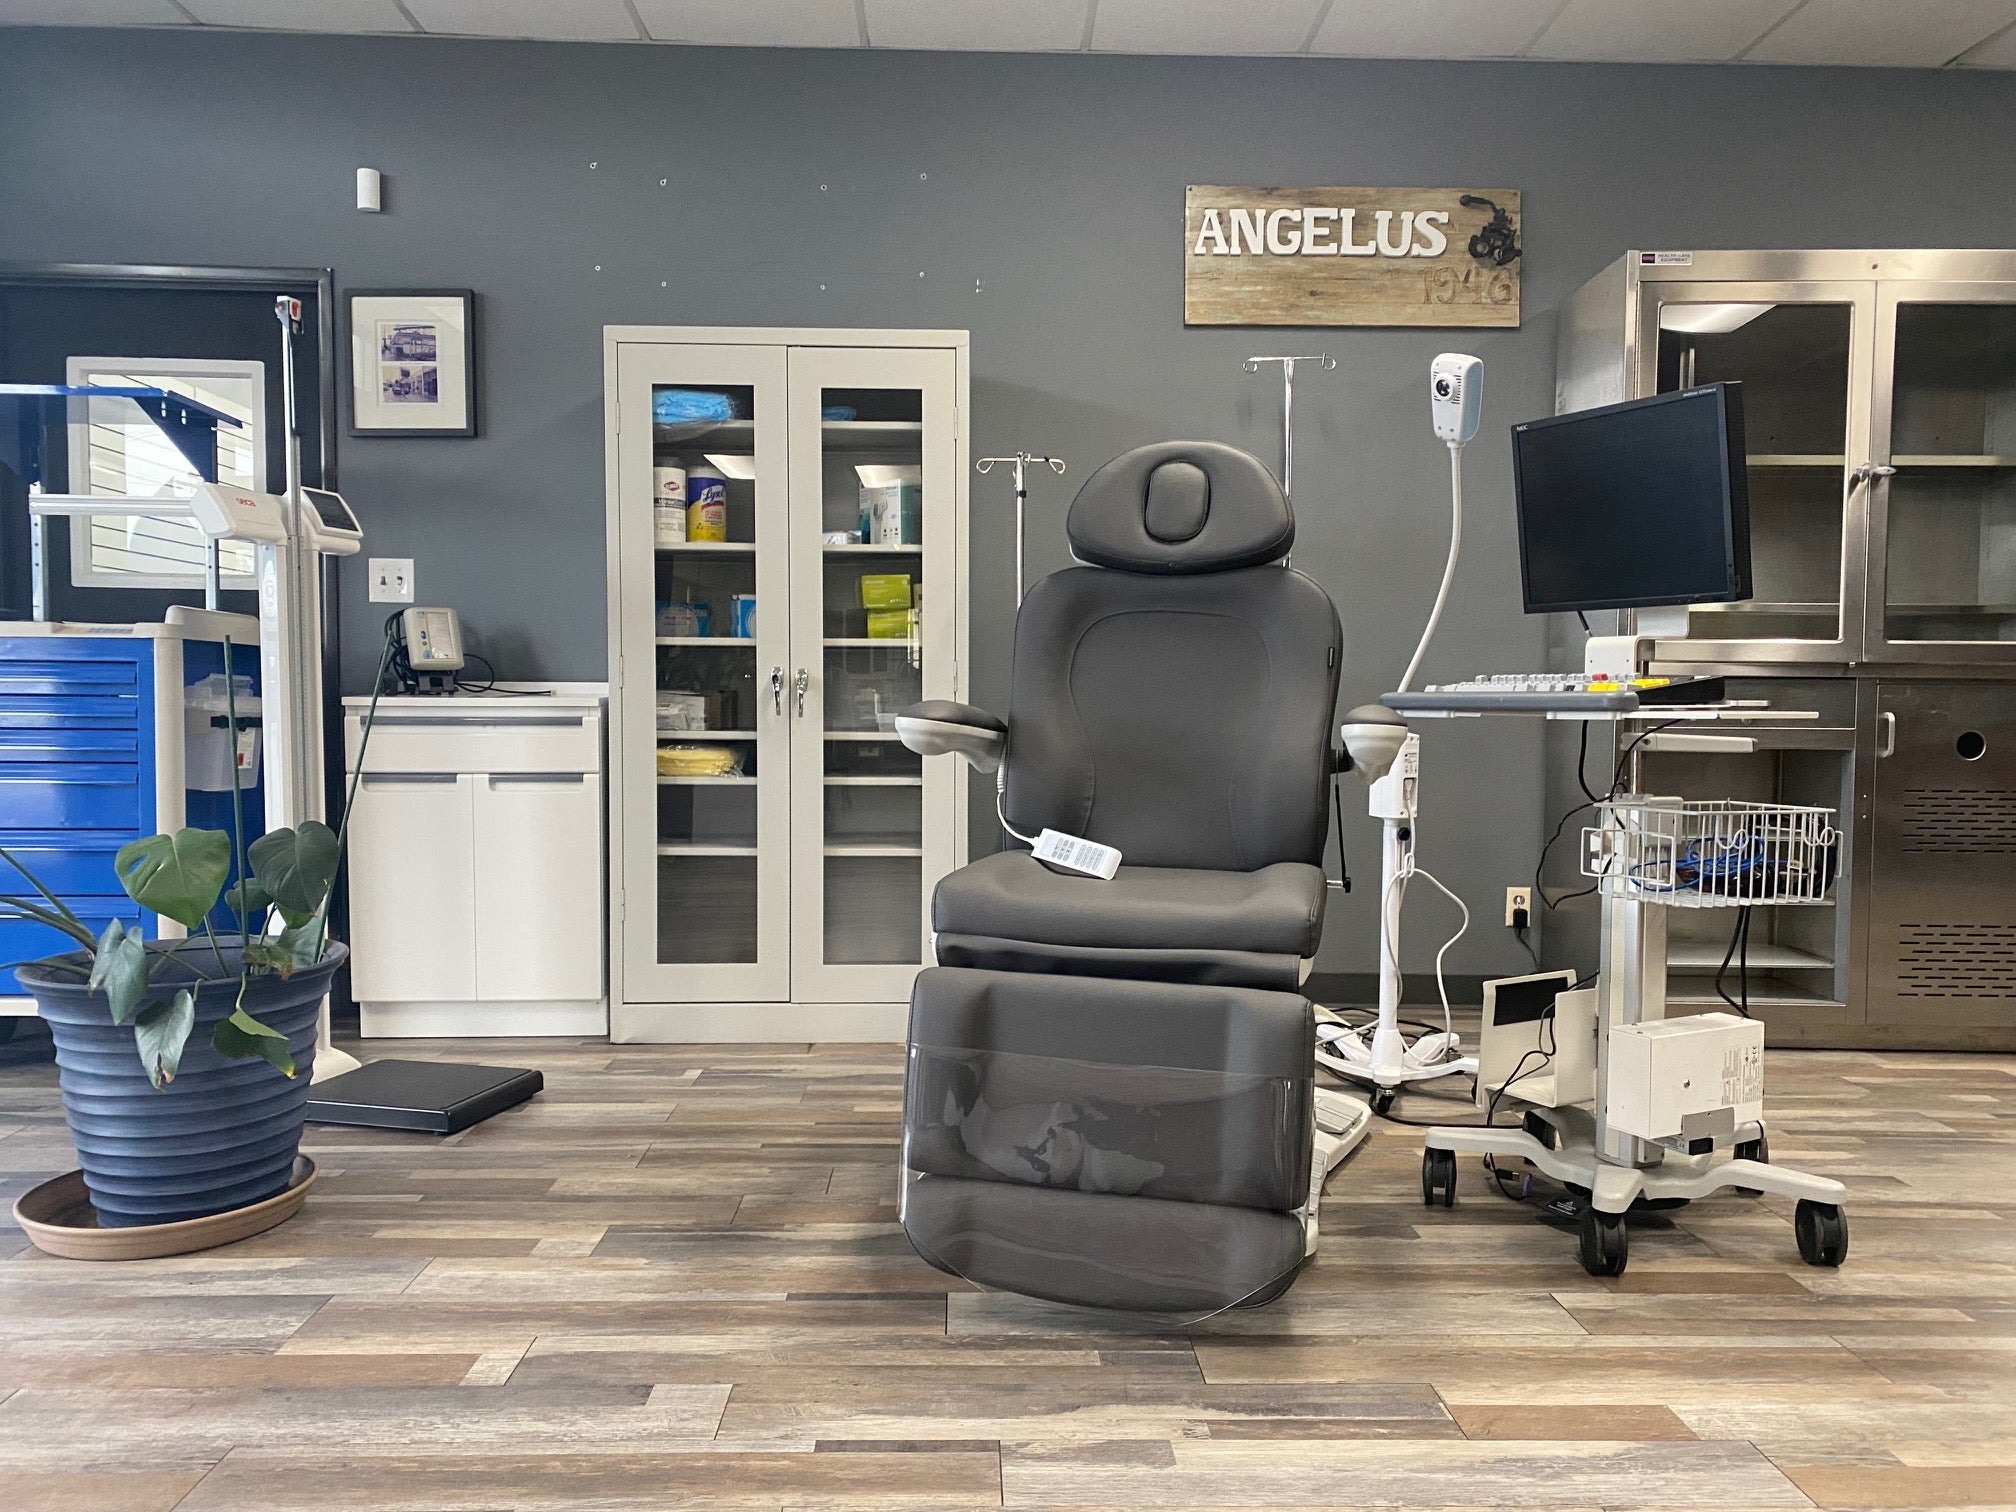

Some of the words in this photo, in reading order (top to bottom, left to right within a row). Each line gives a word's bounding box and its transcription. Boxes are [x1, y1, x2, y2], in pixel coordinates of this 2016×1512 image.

[1193, 207, 1450, 258] ANGELUS
[1417, 266, 1515, 305] 1946
[703, 487, 724, 502] Lysol
